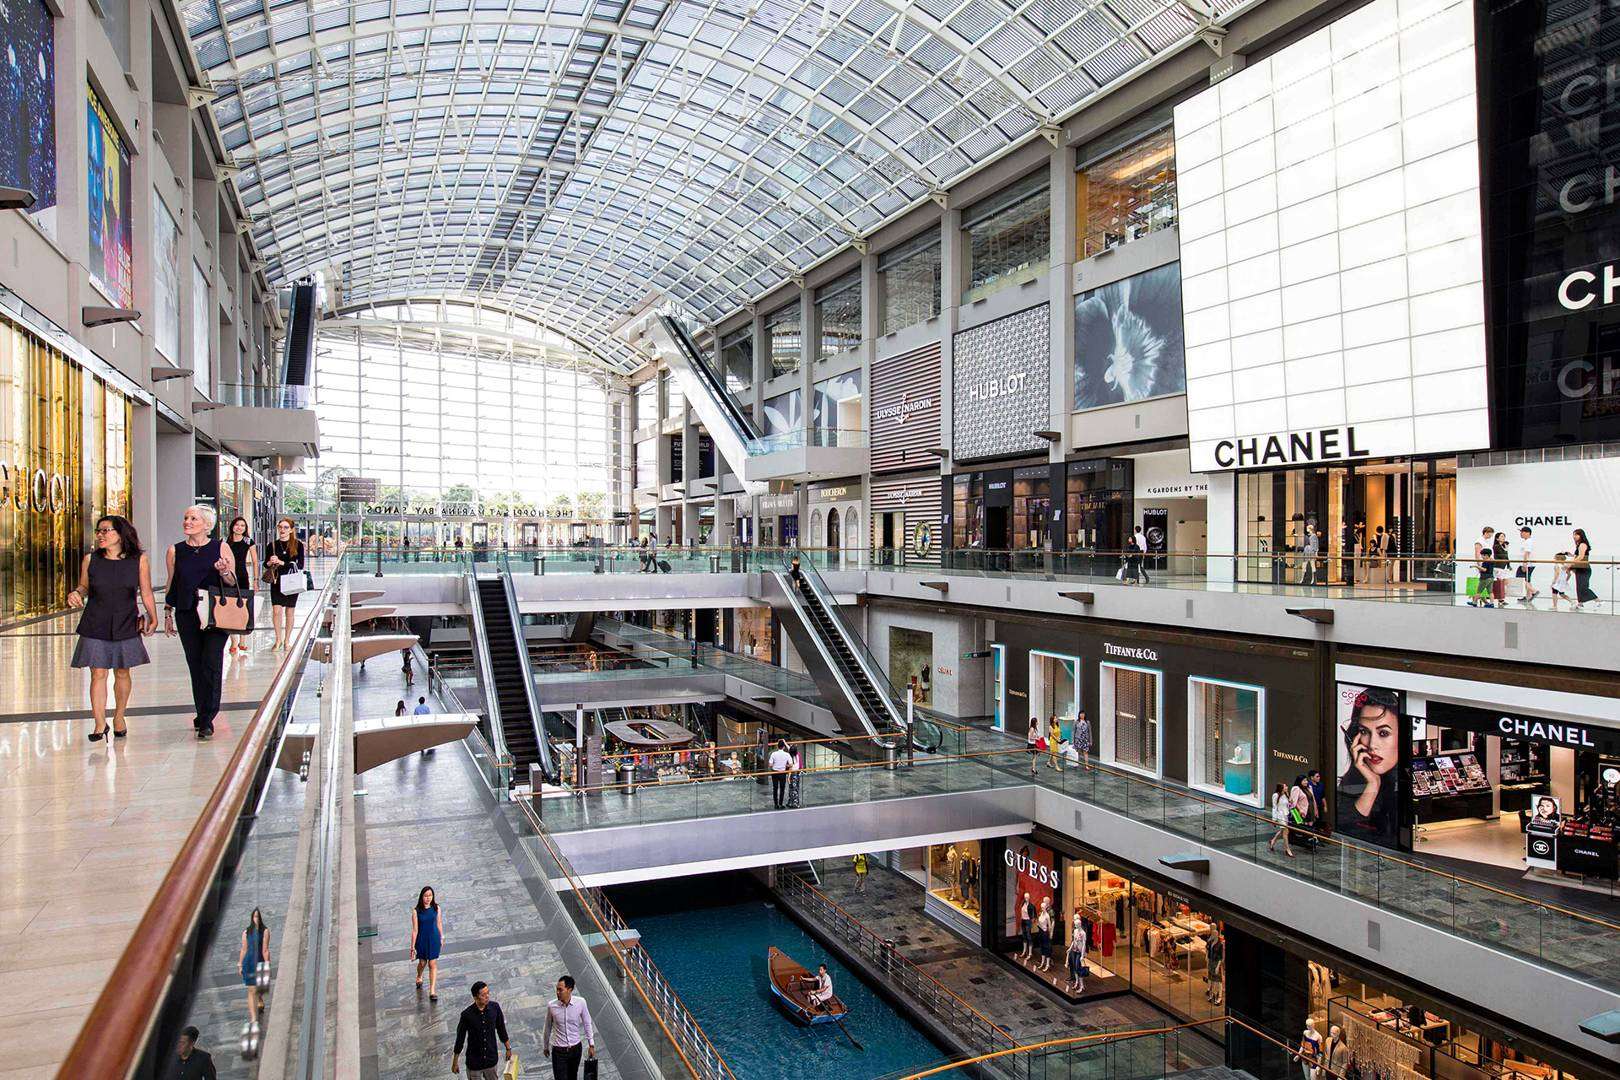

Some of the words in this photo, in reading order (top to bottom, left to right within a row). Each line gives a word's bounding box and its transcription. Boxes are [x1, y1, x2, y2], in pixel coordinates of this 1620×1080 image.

[970, 372, 1027, 402] HUBLOT
[877, 405, 902, 419] ULYSSE
[904, 398, 932, 412] NARDIN
[1214, 426, 1370, 468] CHANEL
[820, 487, 847, 498] BOUCHERON
[1152, 486, 1182, 494] GARDENS
[1514, 516, 1573, 526] CHANEL
[1498, 717, 1595, 747] CHANEL
[1574, 848, 1600, 857] CHANEL
[1004, 849, 1058, 889] GUESS
